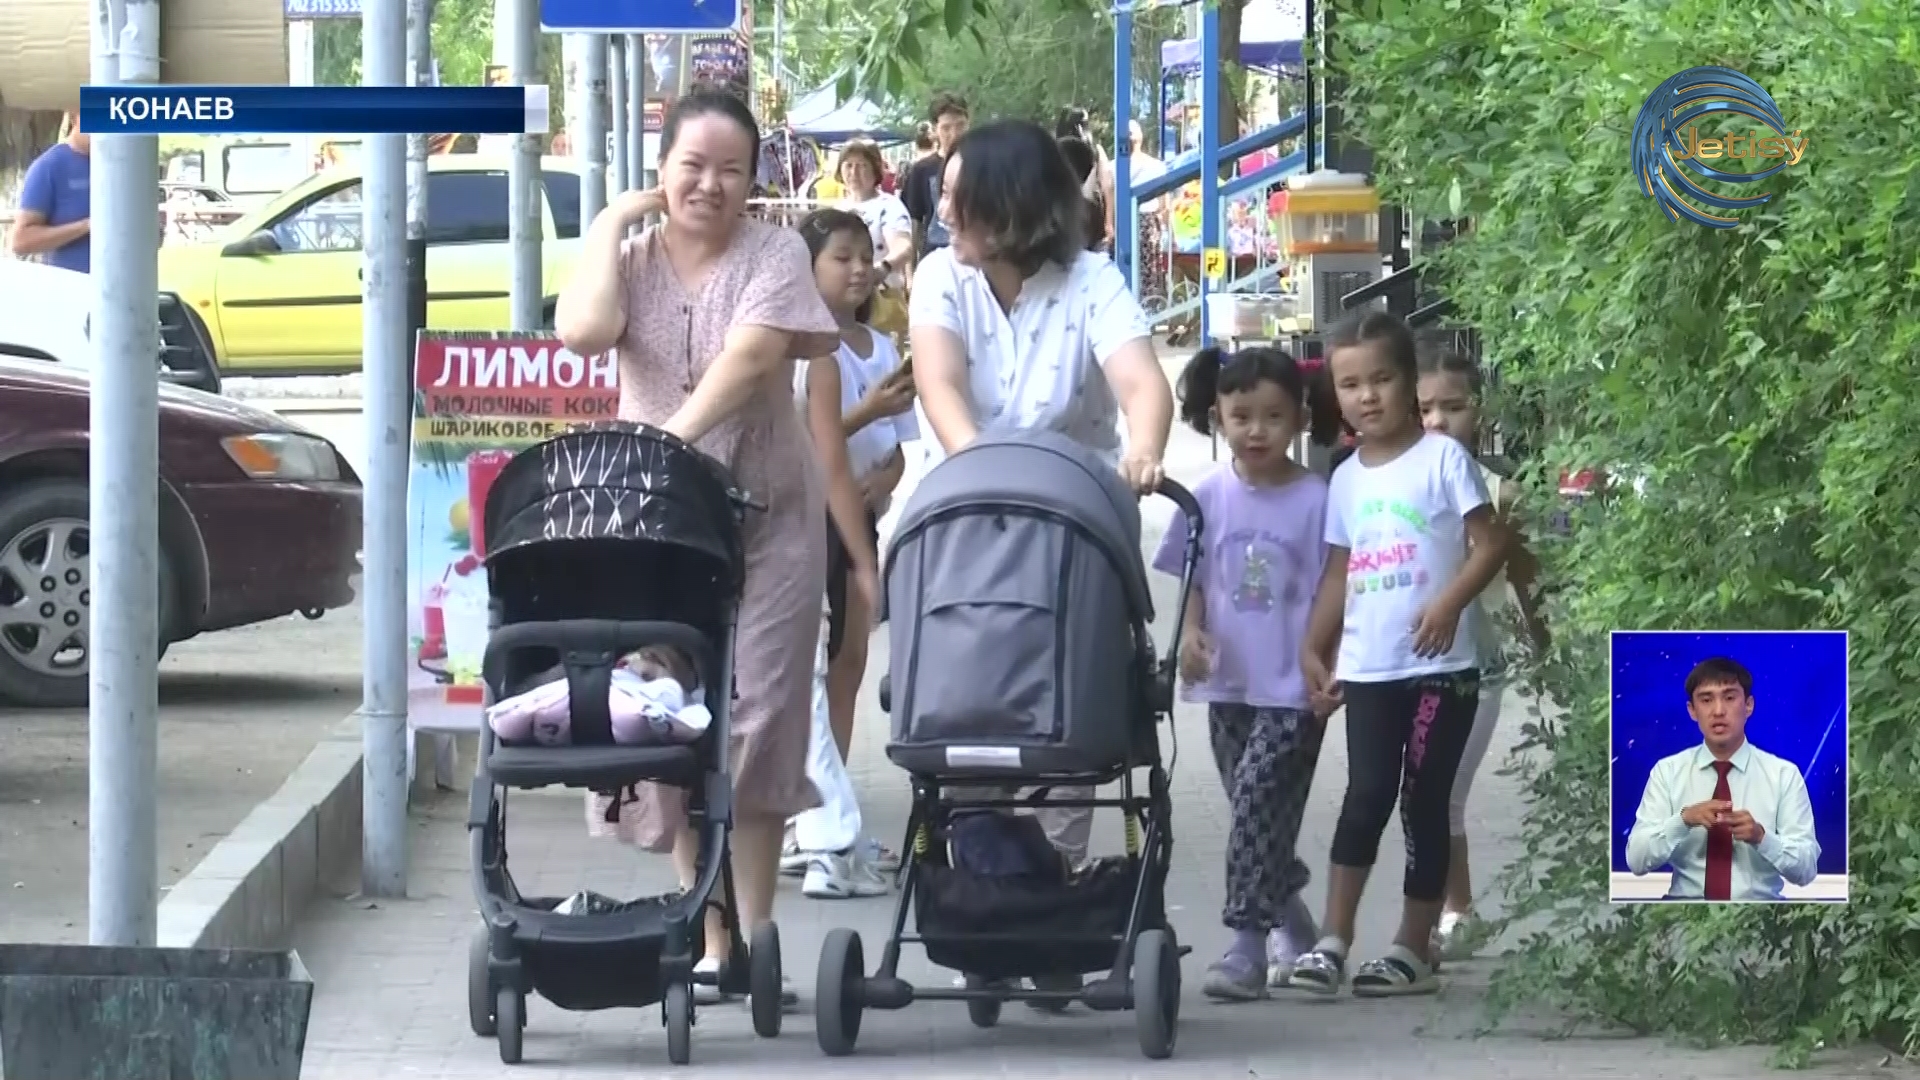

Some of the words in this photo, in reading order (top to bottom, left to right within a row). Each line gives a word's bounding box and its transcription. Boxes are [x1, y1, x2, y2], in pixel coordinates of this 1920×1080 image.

[432, 395, 553, 416] МОЛОЧНЫЕ
[564, 394, 620, 414] КОК
[430, 420, 555, 438] ШАРИКОВОЕ
